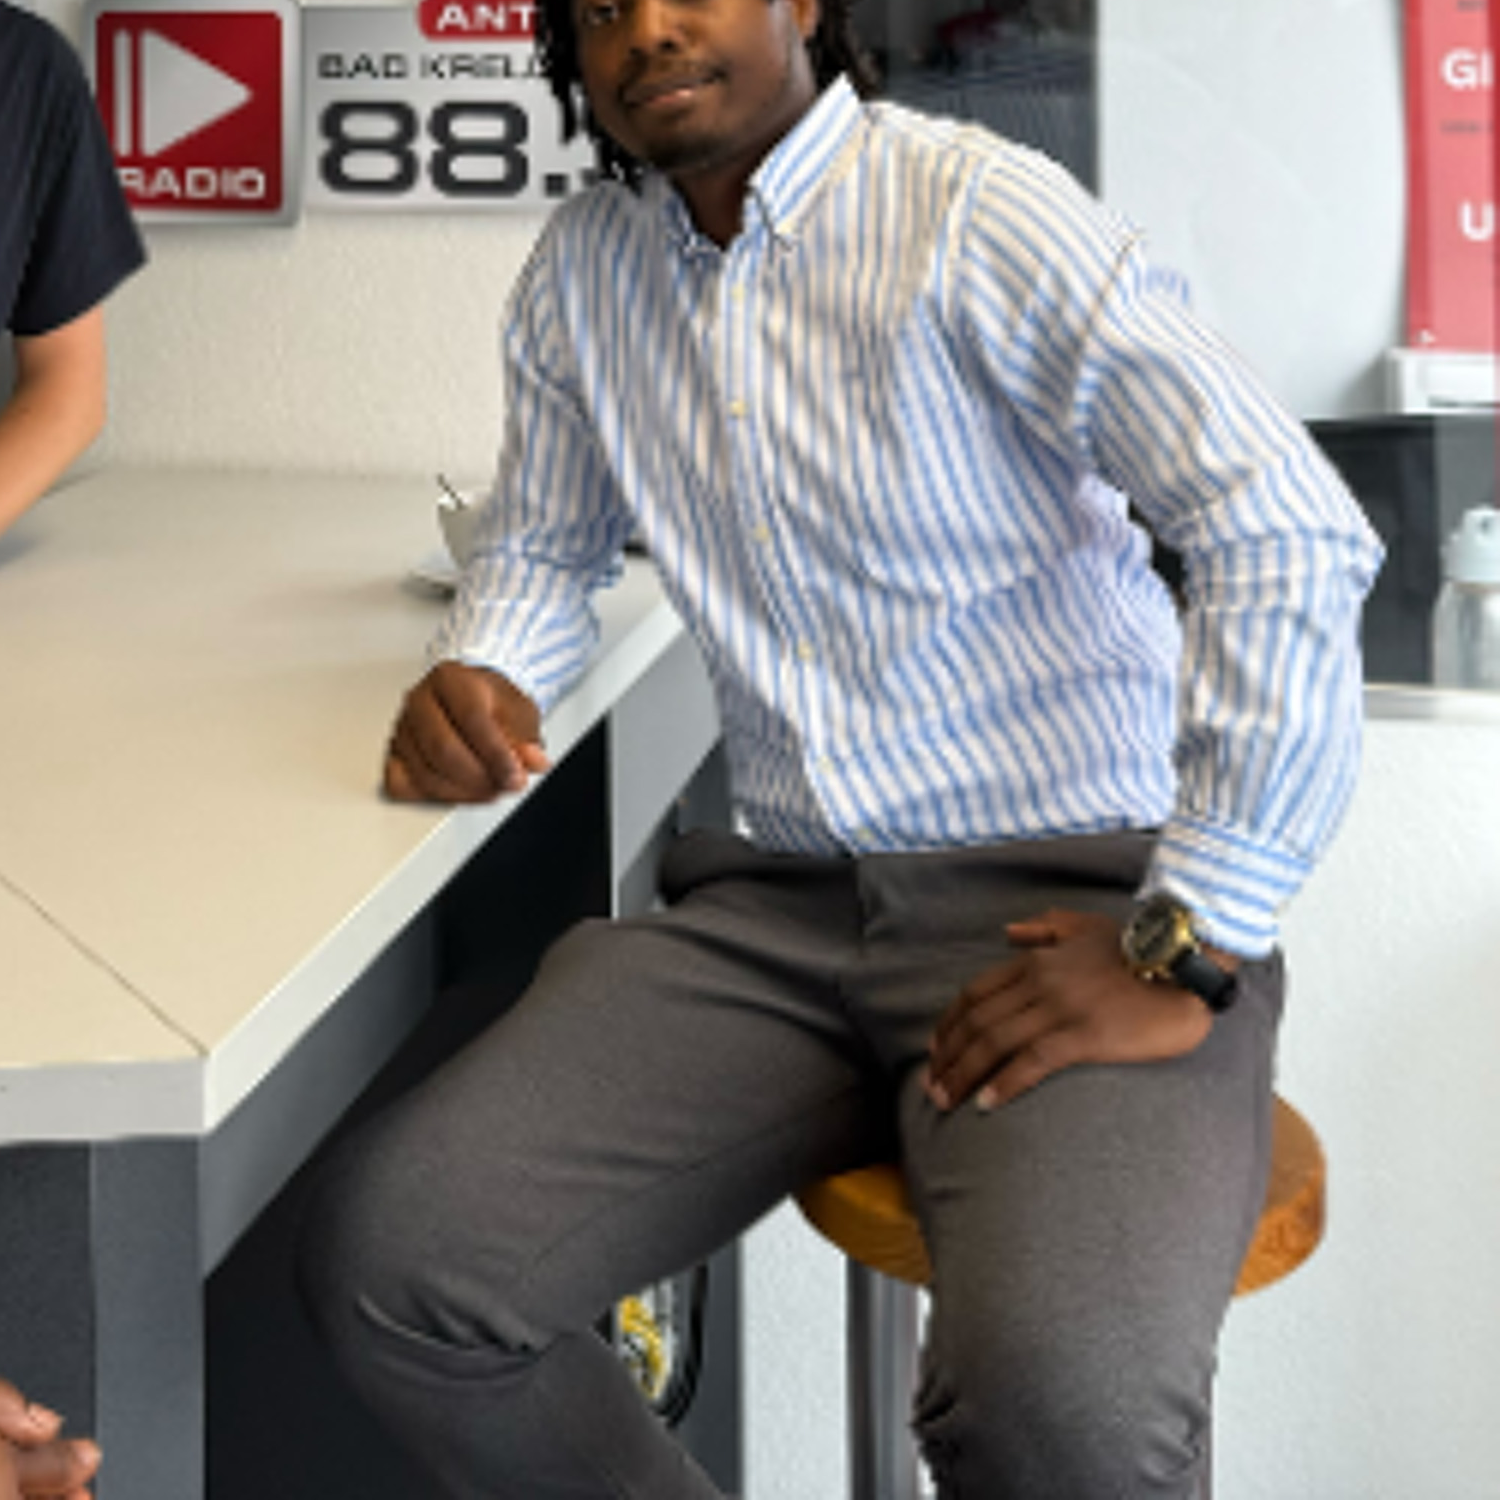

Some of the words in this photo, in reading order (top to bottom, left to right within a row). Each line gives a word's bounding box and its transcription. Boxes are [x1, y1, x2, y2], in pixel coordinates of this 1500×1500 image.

[436, 3, 540, 32] ANT
[319, 54, 408, 79] BAD
[319, 100, 598, 198] 88.
[117, 168, 266, 200] RADIO
